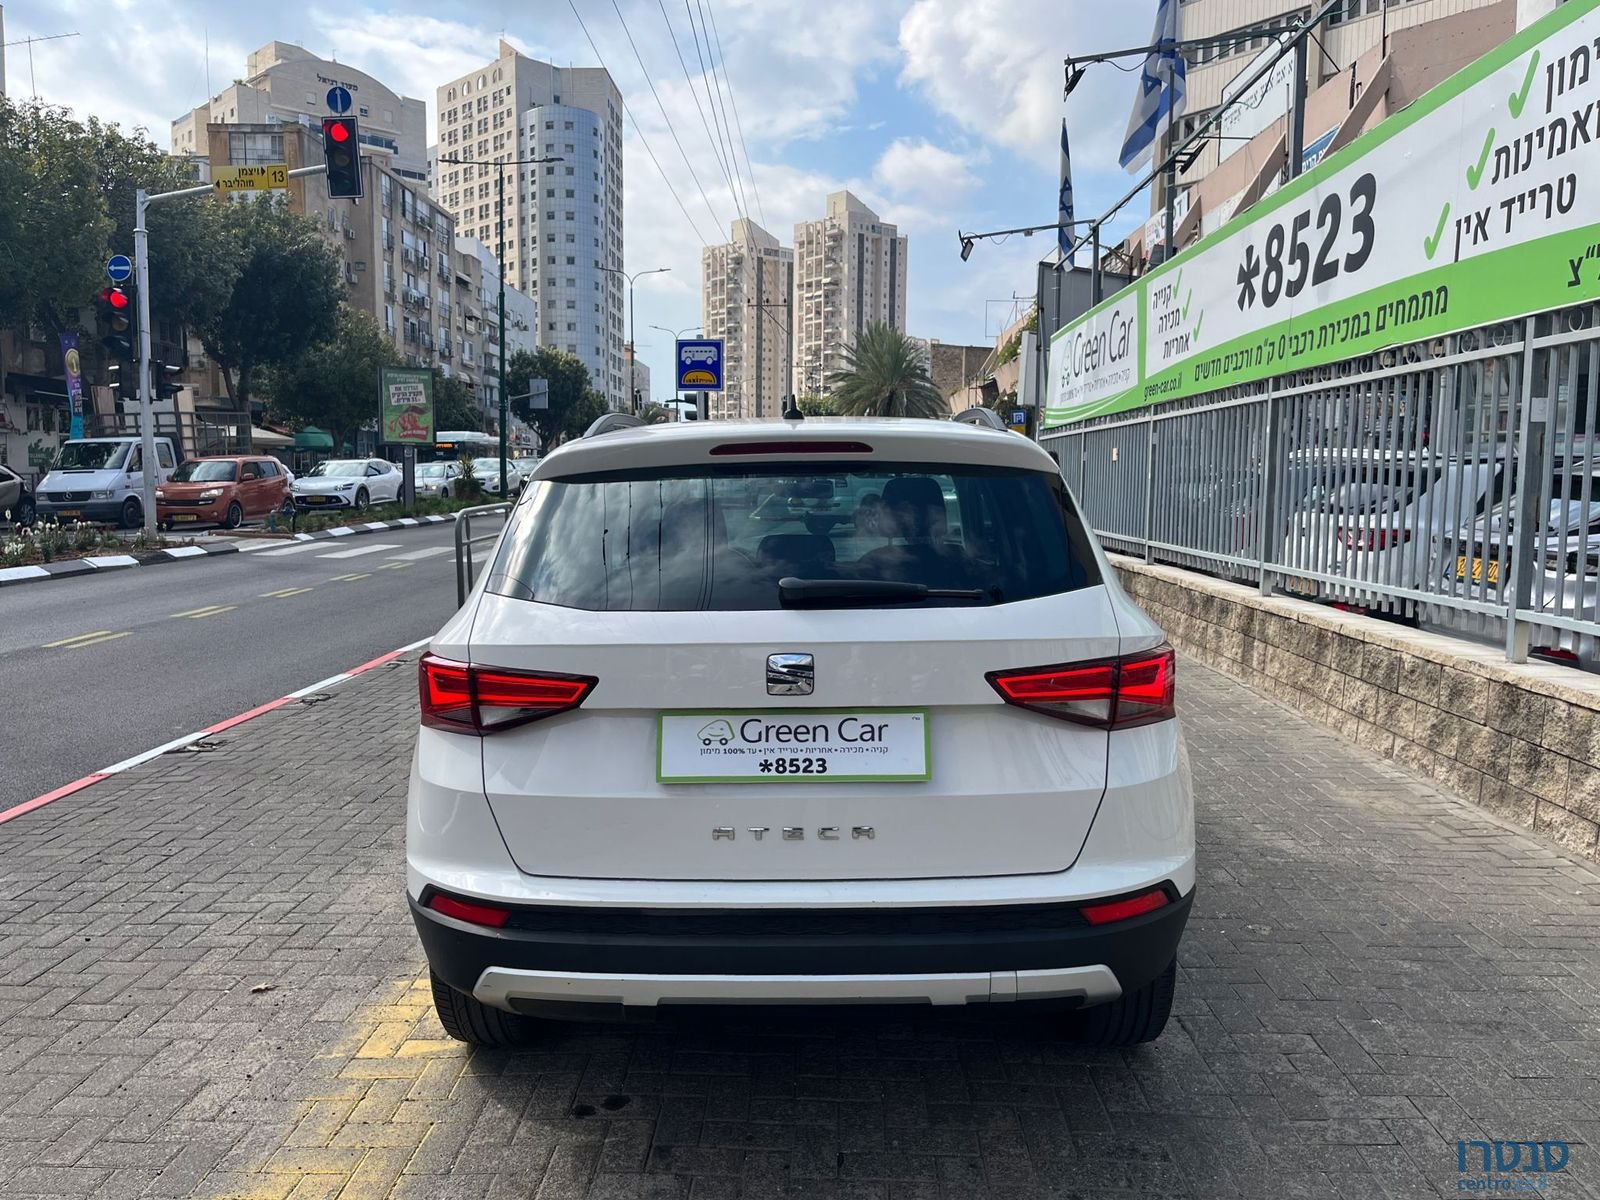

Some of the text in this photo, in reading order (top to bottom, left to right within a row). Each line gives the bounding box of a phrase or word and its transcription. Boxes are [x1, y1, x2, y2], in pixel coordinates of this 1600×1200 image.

[222, 177, 255, 188] מוהליבר
[238, 167, 260, 178] ויצמן
[271, 170, 284, 183] 13
[1454, 173, 1577, 263] טרייד אין
[1153, 284, 1172, 309] קנייה
[1375, 285, 1448, 332] מתמחים
[1158, 308, 1180, 334] מכירה
[1317, 311, 1371, 349] במכירת
[1073, 310, 1134, 378] Green Car
[1163, 332, 1190, 360] אחריות
[1278, 334, 1286, 361] 0
[1289, 329, 1315, 357] רכבי
[1194, 358, 1222, 382] חדשים
[1223, 347, 1253, 374] ורכבים
[1144, 372, 1182, 401] green-car.co.il
[740, 717, 889, 744] Green Car
[700, 748, 721, 756] מימון
[763, 747, 776, 755] אין
[839, 746, 864, 754] מכירה
[871, 746, 889, 755] קניה
[712, 826, 875, 841] ATECA
